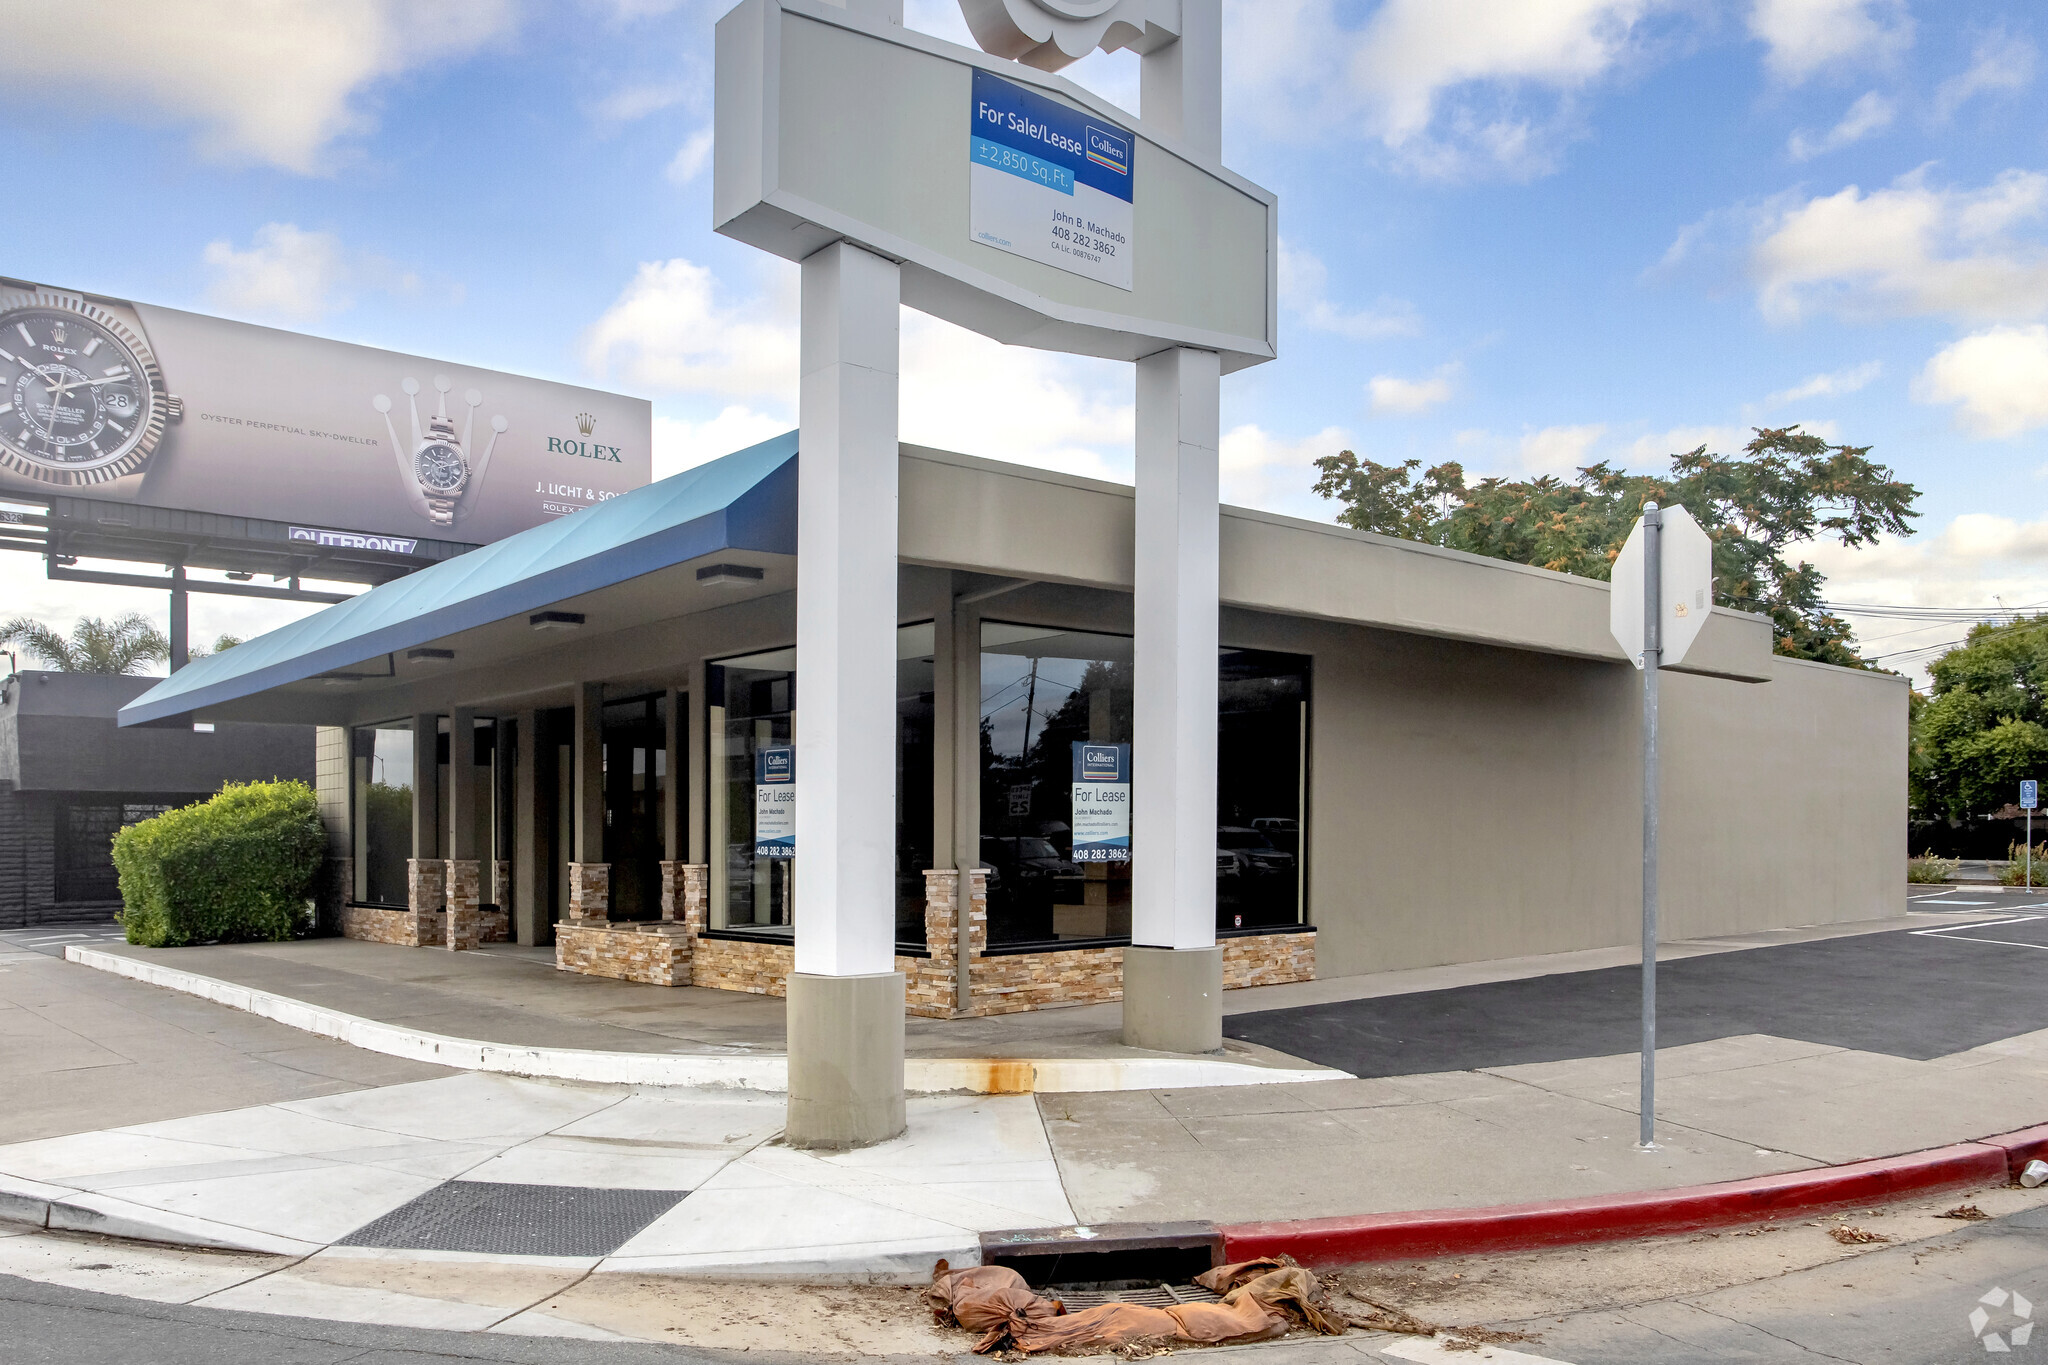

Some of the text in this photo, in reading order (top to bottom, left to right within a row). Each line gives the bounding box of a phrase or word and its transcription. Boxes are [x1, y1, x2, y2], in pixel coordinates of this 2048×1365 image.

[979, 101, 1083, 157] For Sale/Lease
[1090, 135, 1124, 160] Colliers
[979, 143, 1028, 172] ±2,850
[1052, 209, 1126, 244] John B. Machado
[977, 231, 1012, 247] colliers.com
[1051, 225, 1116, 257] 408 282 3862
[1051, 241, 1101, 264] CA Lic. 00876747
[42, 343, 77, 356] ROLEX
[106, 394, 128, 408] 28
[200, 413, 378, 447] OYSTER PERPETUAL SKY-DWELLER
[546, 436, 623, 463] ROLEX
[535, 481, 545, 493] J.
[548, 483, 583, 499] LICHT
[585, 488, 595, 501] &
[543, 503, 574, 514] ROLEX
[767, 755, 788, 766] Colliers
[1086, 751, 1115, 763] Colliers
[758, 788, 795, 803] For Lease
[1075, 787, 1126, 803] For Lease
[1074, 808, 1113, 816] John Machado
[756, 845, 796, 856] 408 282 3862
[1073, 848, 1127, 860] 408 282 3862
